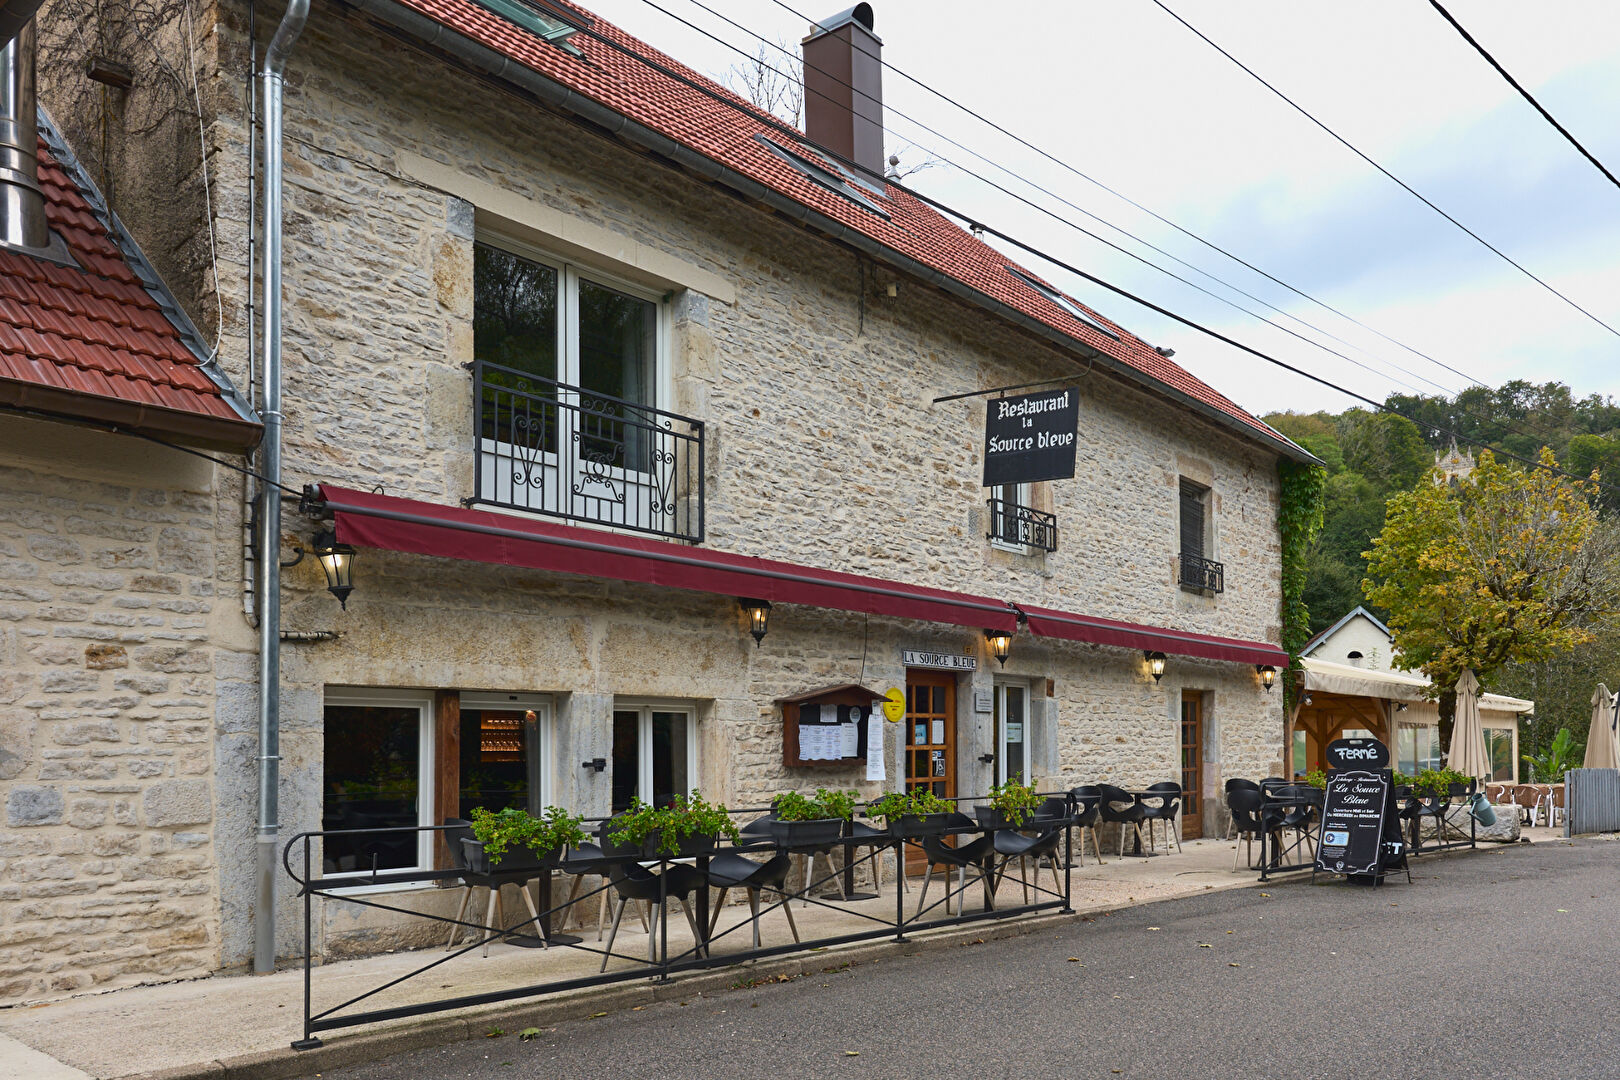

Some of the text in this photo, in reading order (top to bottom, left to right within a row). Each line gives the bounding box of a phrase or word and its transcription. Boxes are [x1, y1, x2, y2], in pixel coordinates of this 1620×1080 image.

[997, 390, 1069, 420] Restaurant
[1022, 417, 1033, 428] la
[988, 431, 1074, 453] Source bleue
[904, 651, 976, 669] LA SOURCE BLEUE
[1333, 783, 1381, 793] La Source
[1341, 794, 1369, 804] Bleue
